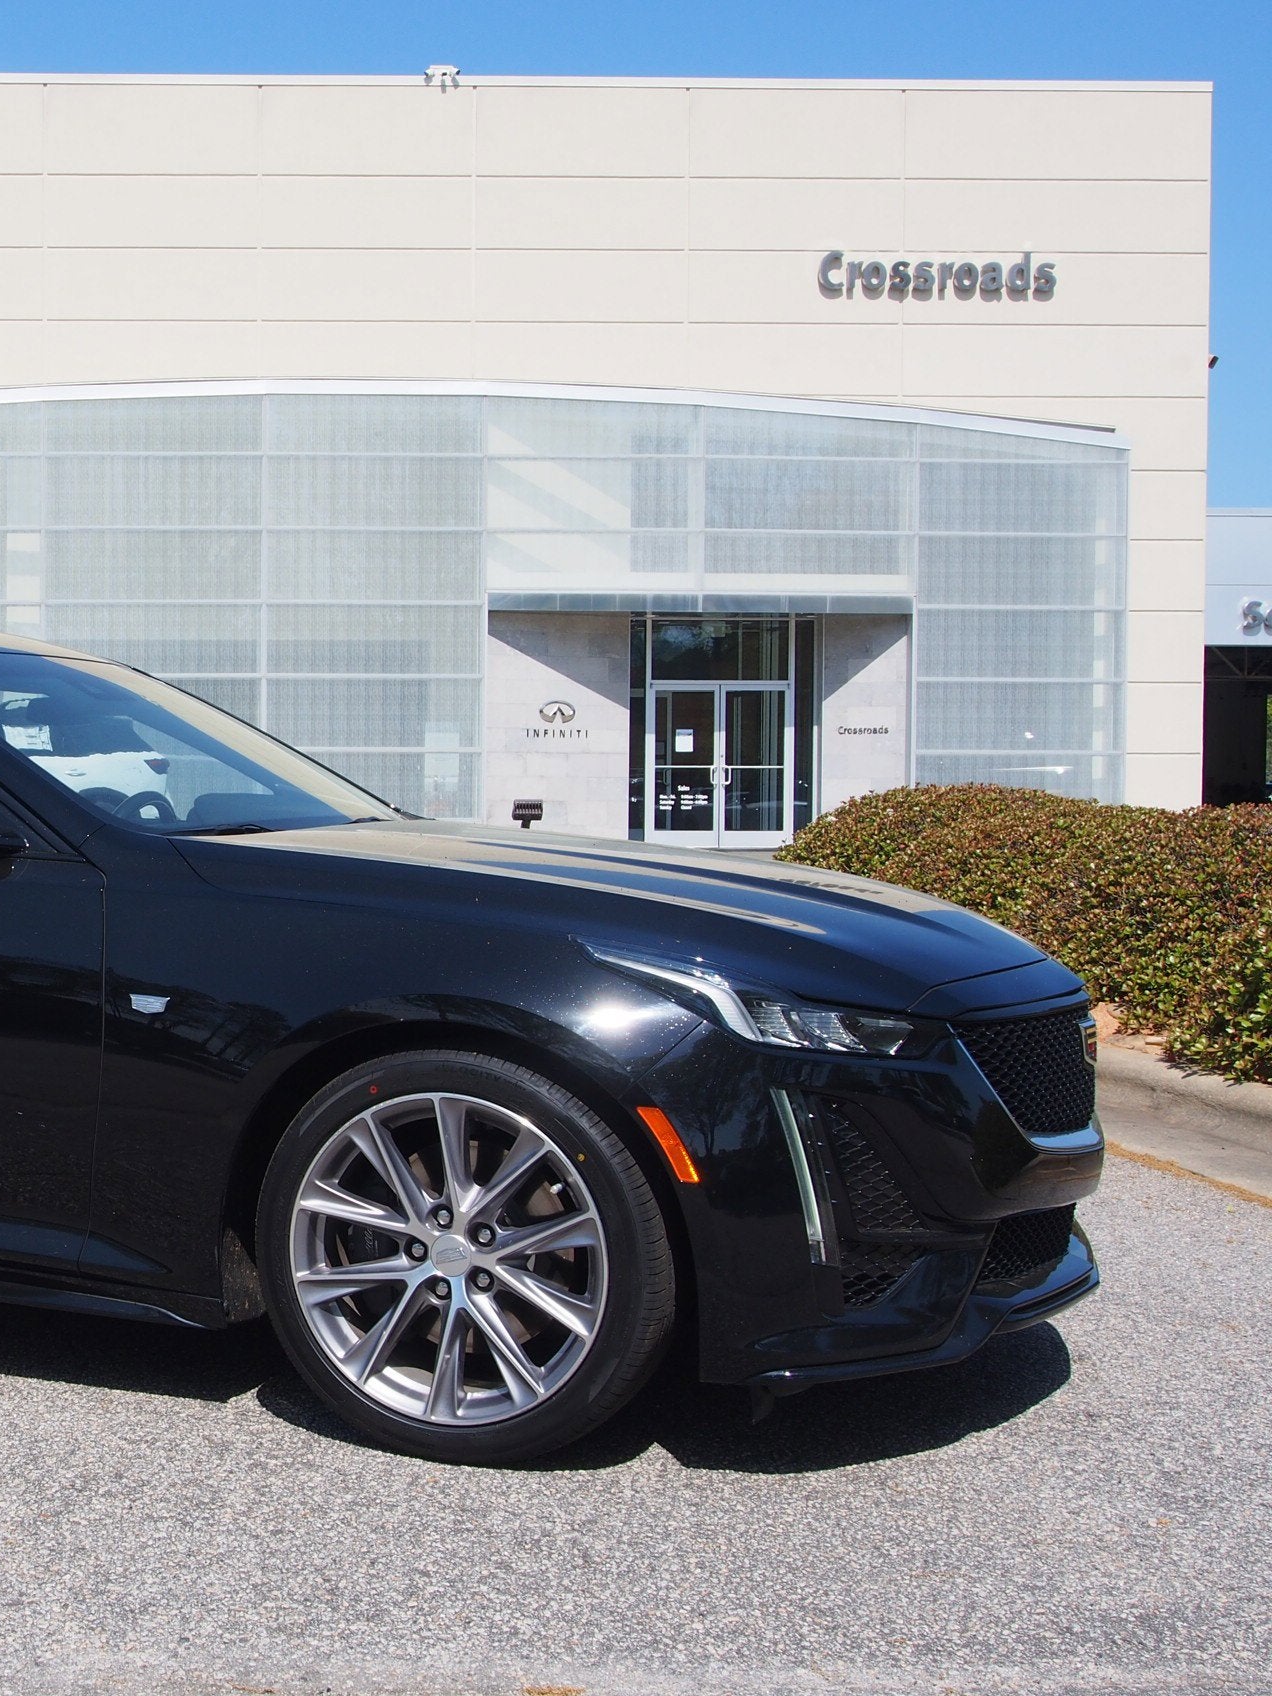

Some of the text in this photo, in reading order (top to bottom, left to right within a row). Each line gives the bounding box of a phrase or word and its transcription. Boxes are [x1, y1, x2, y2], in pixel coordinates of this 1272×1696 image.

[818, 250, 1058, 293] Crossroads
[526, 728, 589, 739] INFINITI
[837, 725, 890, 735] Crossroads
